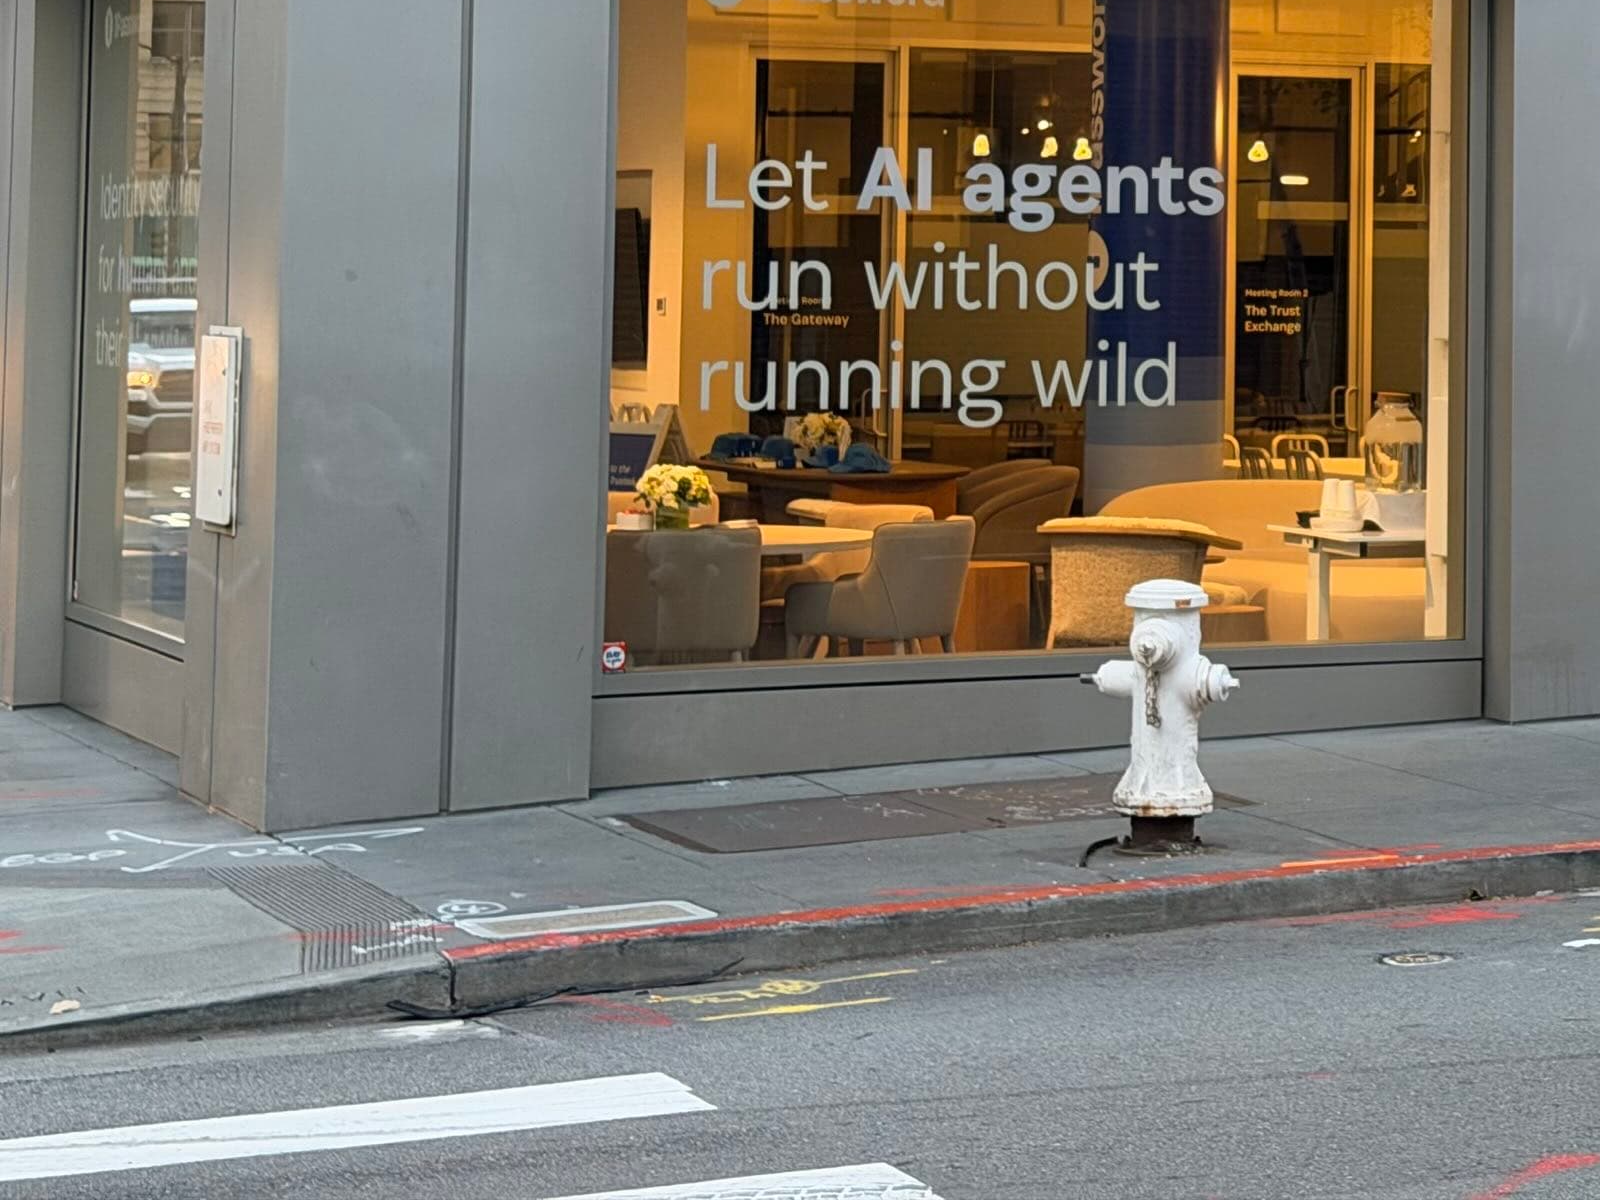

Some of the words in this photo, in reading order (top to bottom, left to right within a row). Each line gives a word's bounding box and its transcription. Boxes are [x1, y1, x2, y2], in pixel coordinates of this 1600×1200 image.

[704, 144, 828, 211] Let
[857, 147, 933, 212] AI
[964, 156, 1226, 233] agents
[702, 259, 831, 311] run
[863, 241, 1160, 311] without
[763, 313, 788, 325] The
[791, 313, 850, 328] Gateway
[1244, 305, 1268, 316] The
[1270, 305, 1301, 316] Trust
[1244, 321, 1302, 335] Exchange
[700, 340, 1006, 428] running
[1031, 340, 1178, 409] wild
